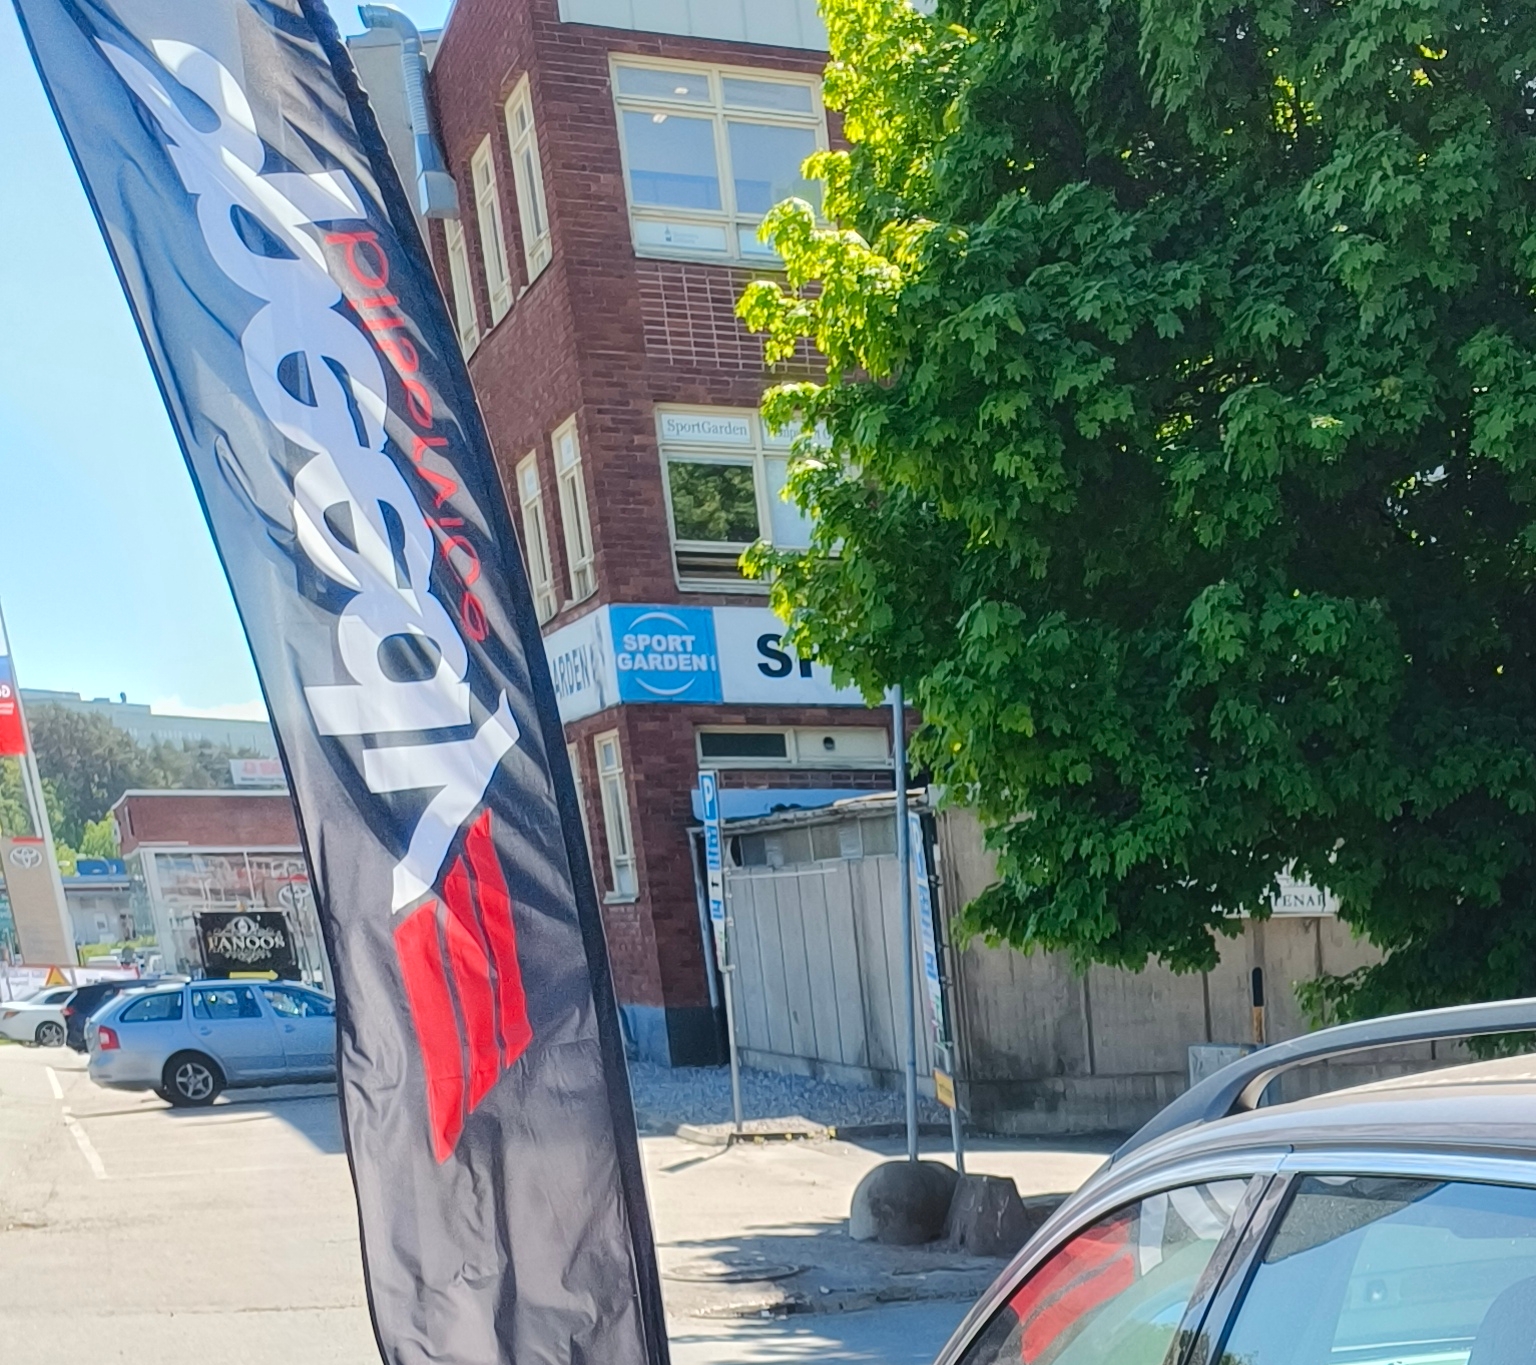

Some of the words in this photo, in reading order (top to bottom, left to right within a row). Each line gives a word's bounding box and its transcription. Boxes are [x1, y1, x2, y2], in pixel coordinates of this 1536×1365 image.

[666, 418, 748, 436] SportGarden
[623, 633, 696, 653] SPORT
[617, 653, 709, 672] GARDEN
